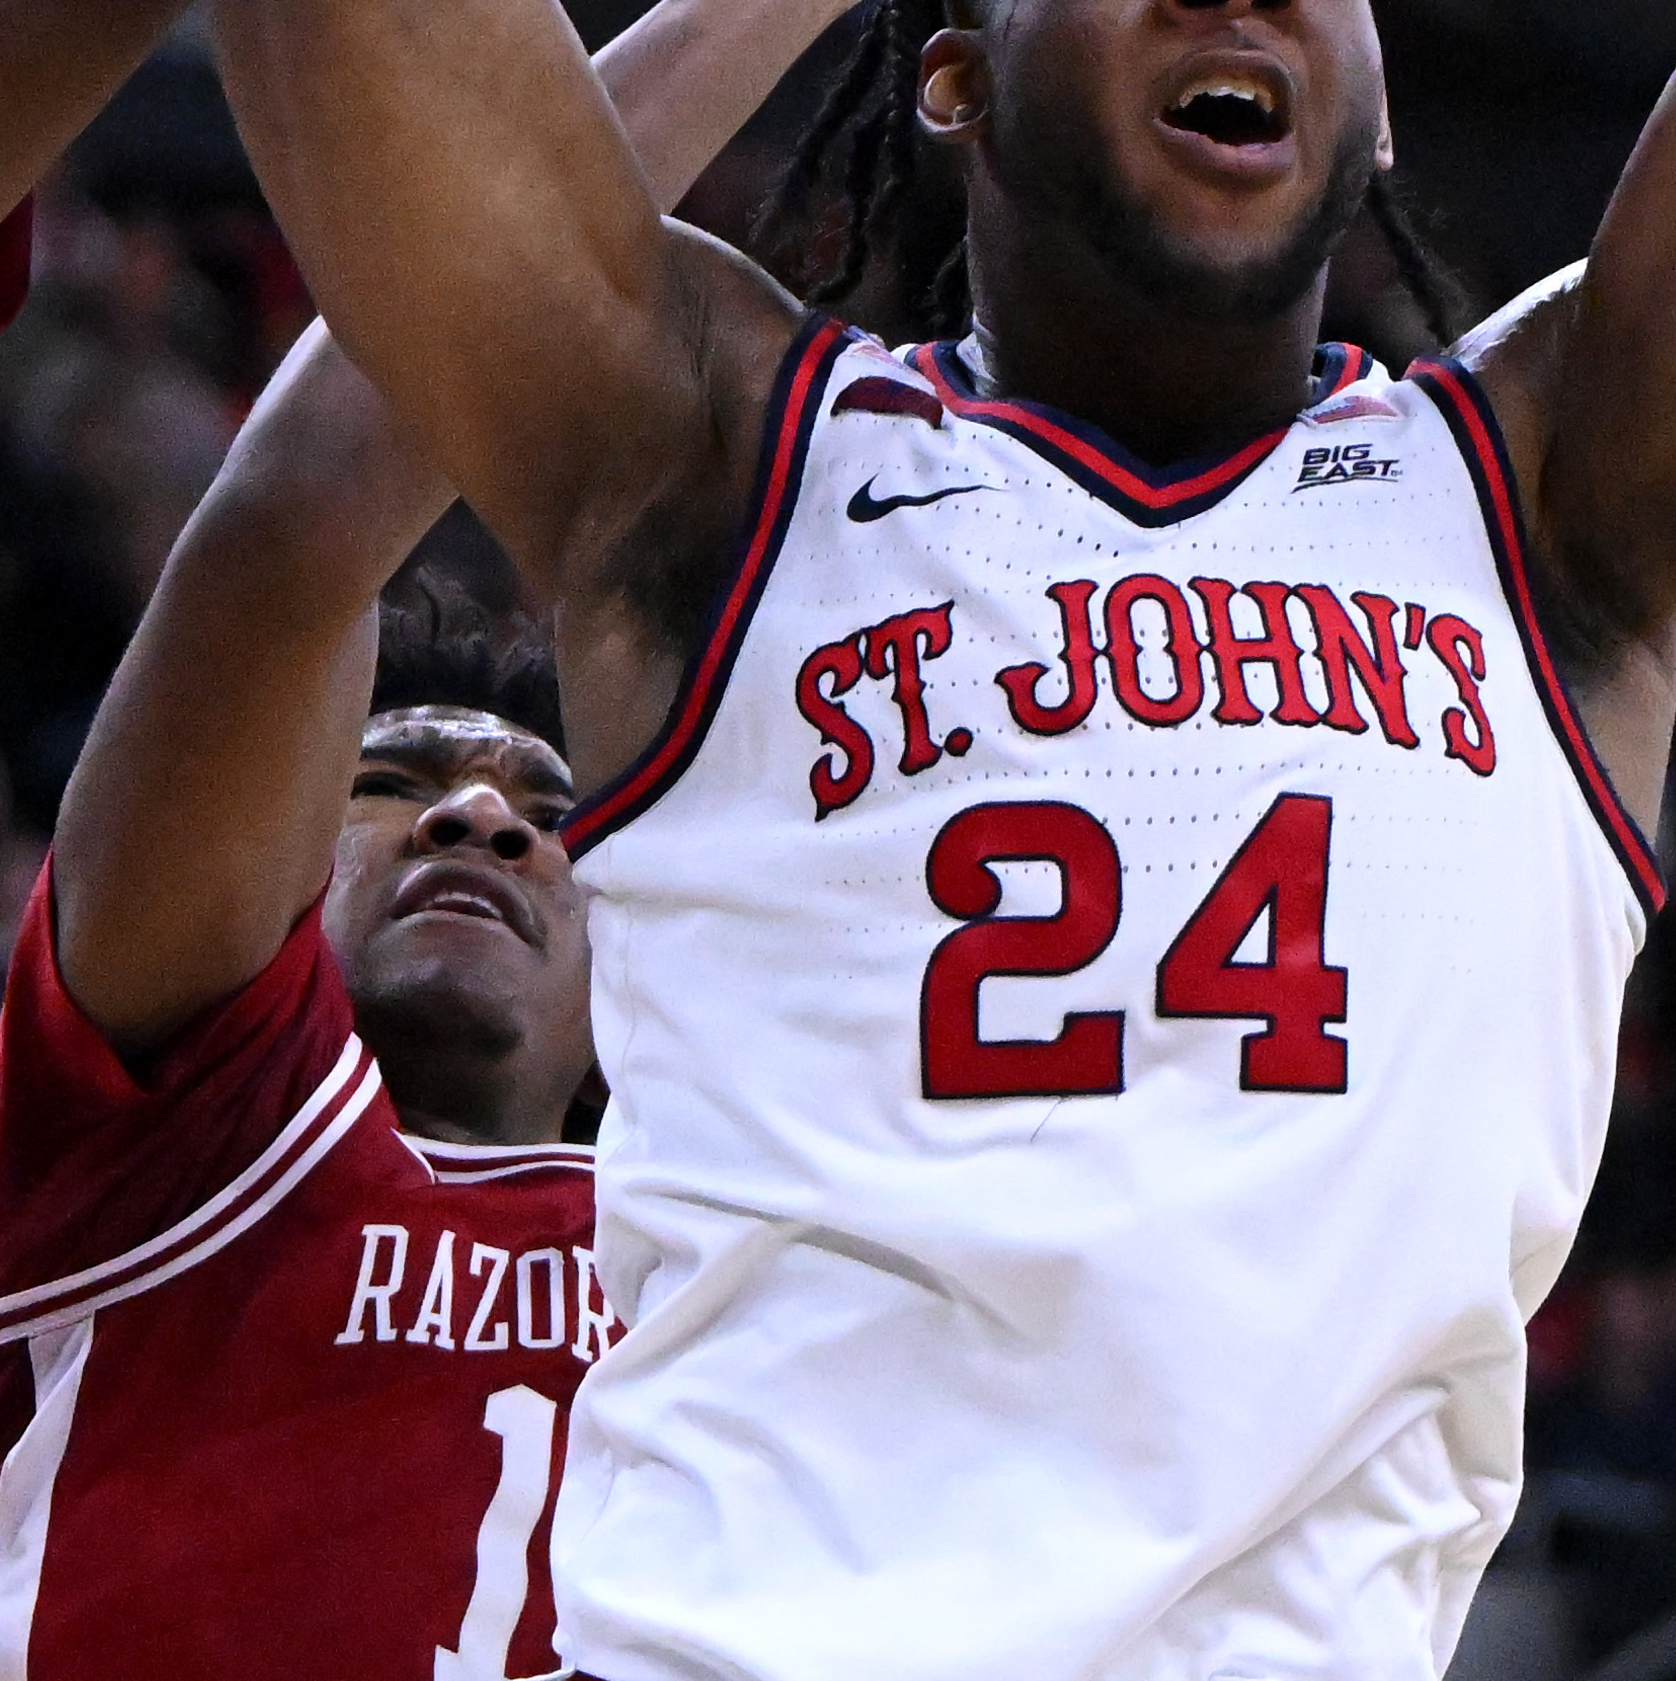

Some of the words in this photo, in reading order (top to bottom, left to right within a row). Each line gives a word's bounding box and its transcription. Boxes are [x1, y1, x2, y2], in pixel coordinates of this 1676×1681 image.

[1297, 460, 1400, 483] EAST
[1303, 444, 1373, 465] BIG
[795, 599, 973, 821] ST.
[994, 573, 1498, 779] JOHN'S
[921, 791, 1348, 1100] 24
